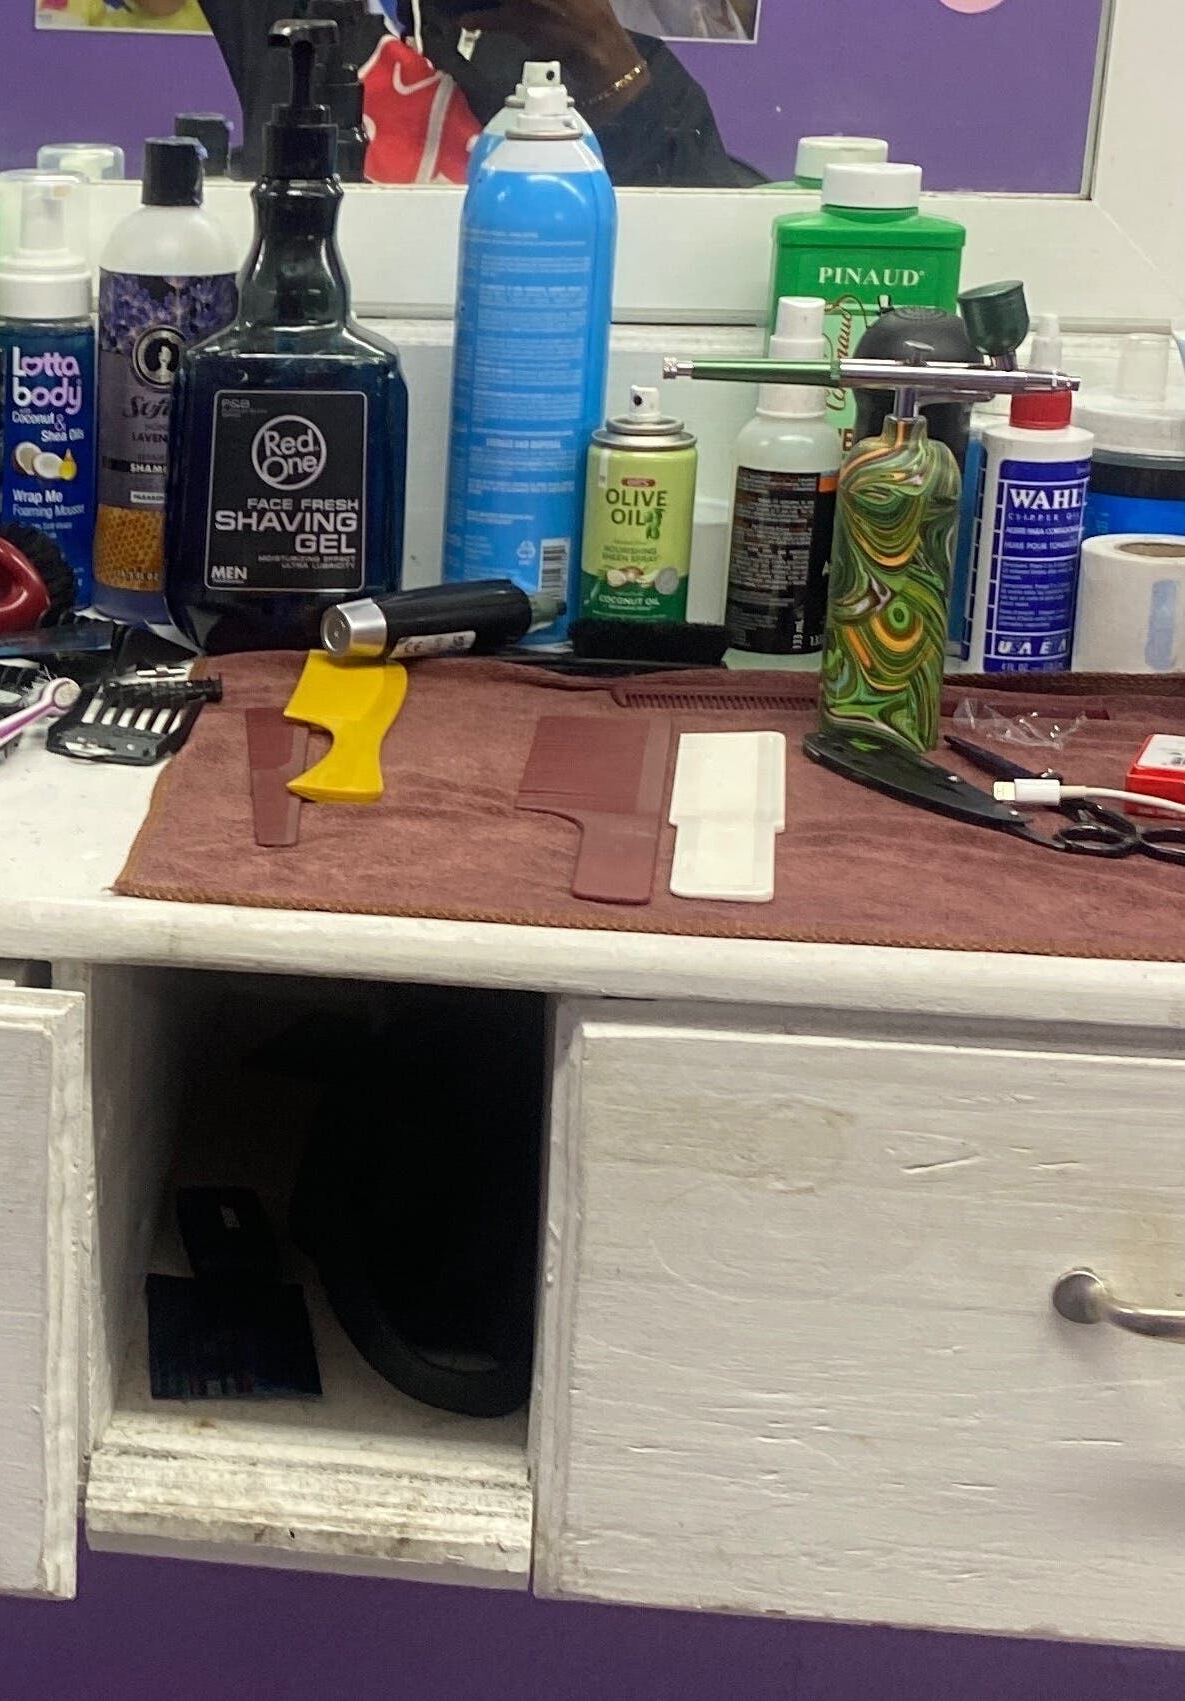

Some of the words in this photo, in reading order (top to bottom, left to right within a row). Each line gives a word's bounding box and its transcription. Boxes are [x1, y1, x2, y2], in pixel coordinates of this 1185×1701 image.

[819, 267, 919, 286] PINAUD
[12, 346, 80, 377] Lotta
[12, 377, 82, 415] body
[12, 410, 54, 424] Coconut
[41, 429, 67, 442] Shea
[265, 430, 316, 457] Red
[261, 455, 318, 483] One
[12, 488, 43, 505] Wrap
[45, 489, 64, 503] Me
[247, 498, 293, 511] FACE
[301, 499, 359, 512] FRESH
[605, 488, 667, 507] OLIVE
[1009, 488, 1081, 510] WAHL
[13, 503, 53, 519] Foaming
[611, 508, 646, 526] OIL
[215, 510, 358, 533] SHAVING
[295, 533, 356, 554] GEL
[211, 565, 248, 580] MEN
